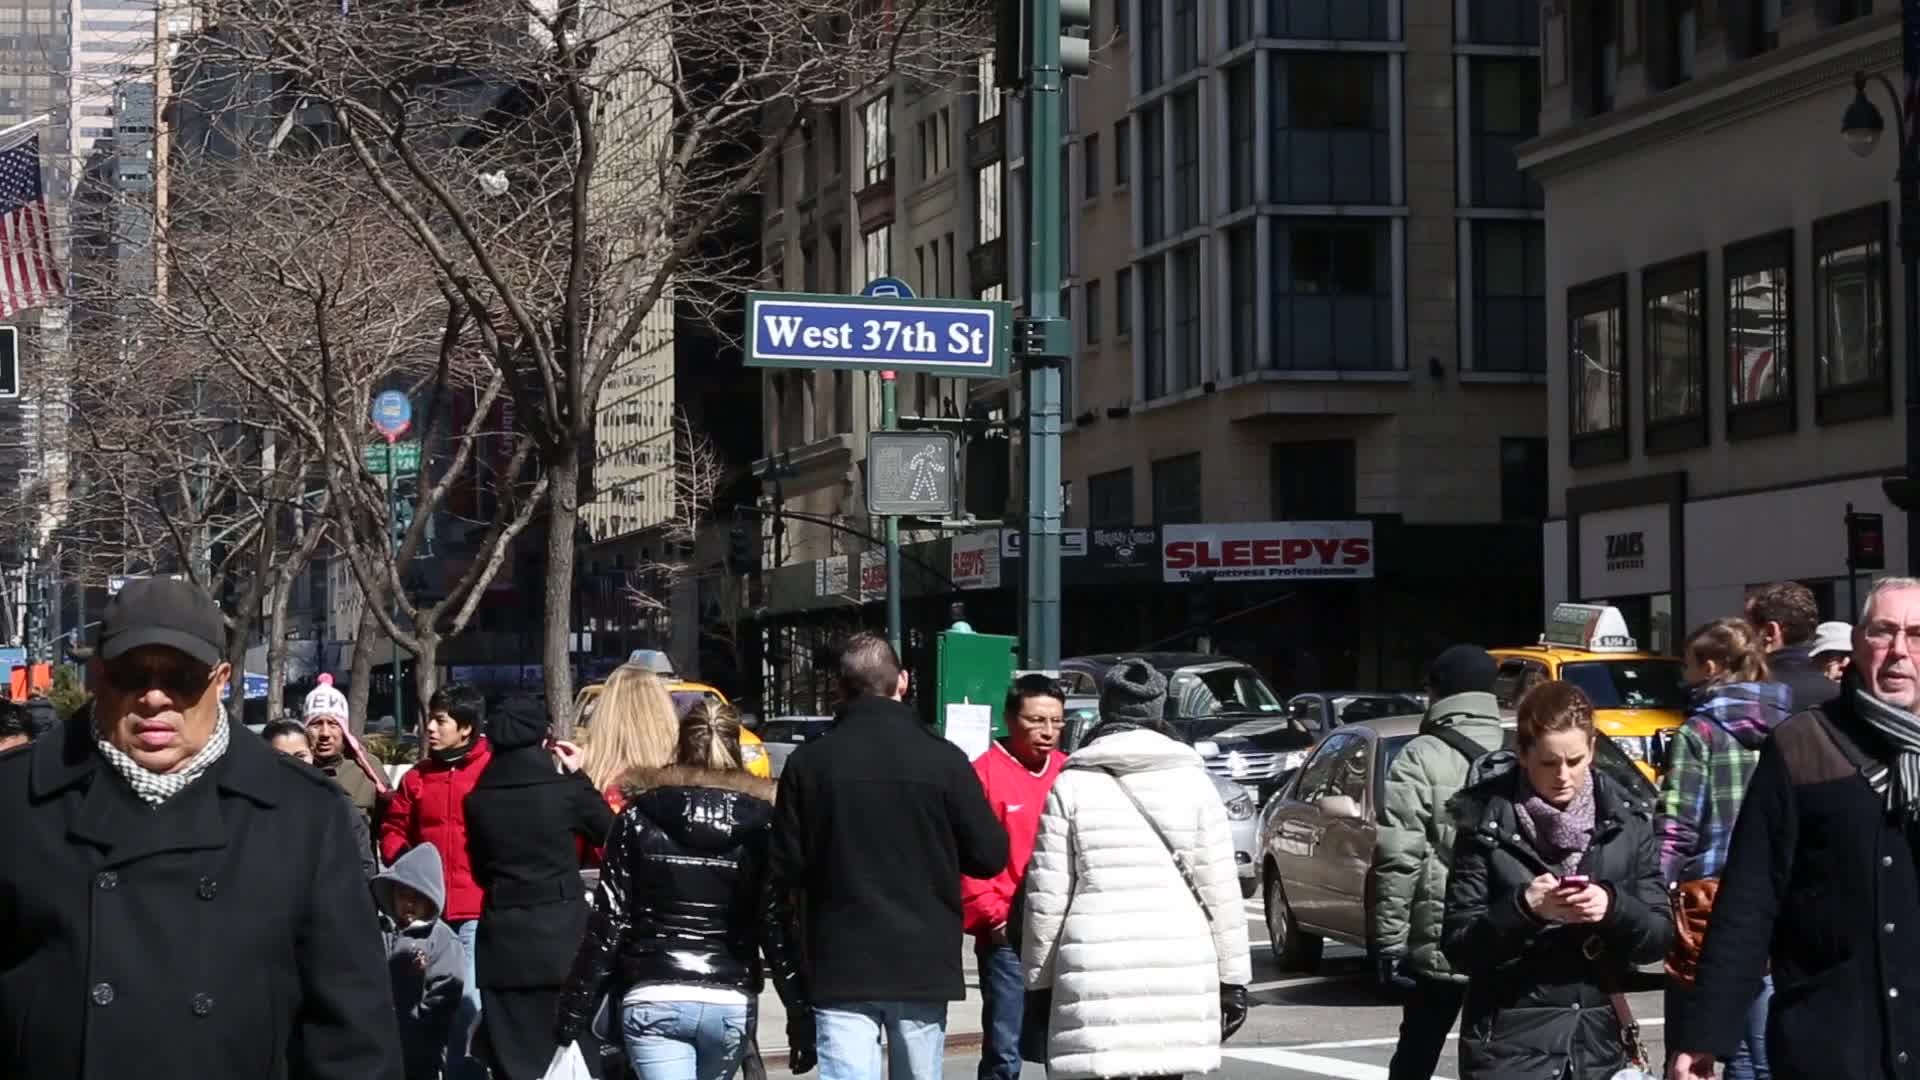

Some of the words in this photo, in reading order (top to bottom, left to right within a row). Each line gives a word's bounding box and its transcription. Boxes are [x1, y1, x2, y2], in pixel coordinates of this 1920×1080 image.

[763, 315, 853, 349] West
[862, 319, 937, 353] 37th
[948, 322, 984, 355] St
[1165, 537, 1371, 569] SLEEPYS
